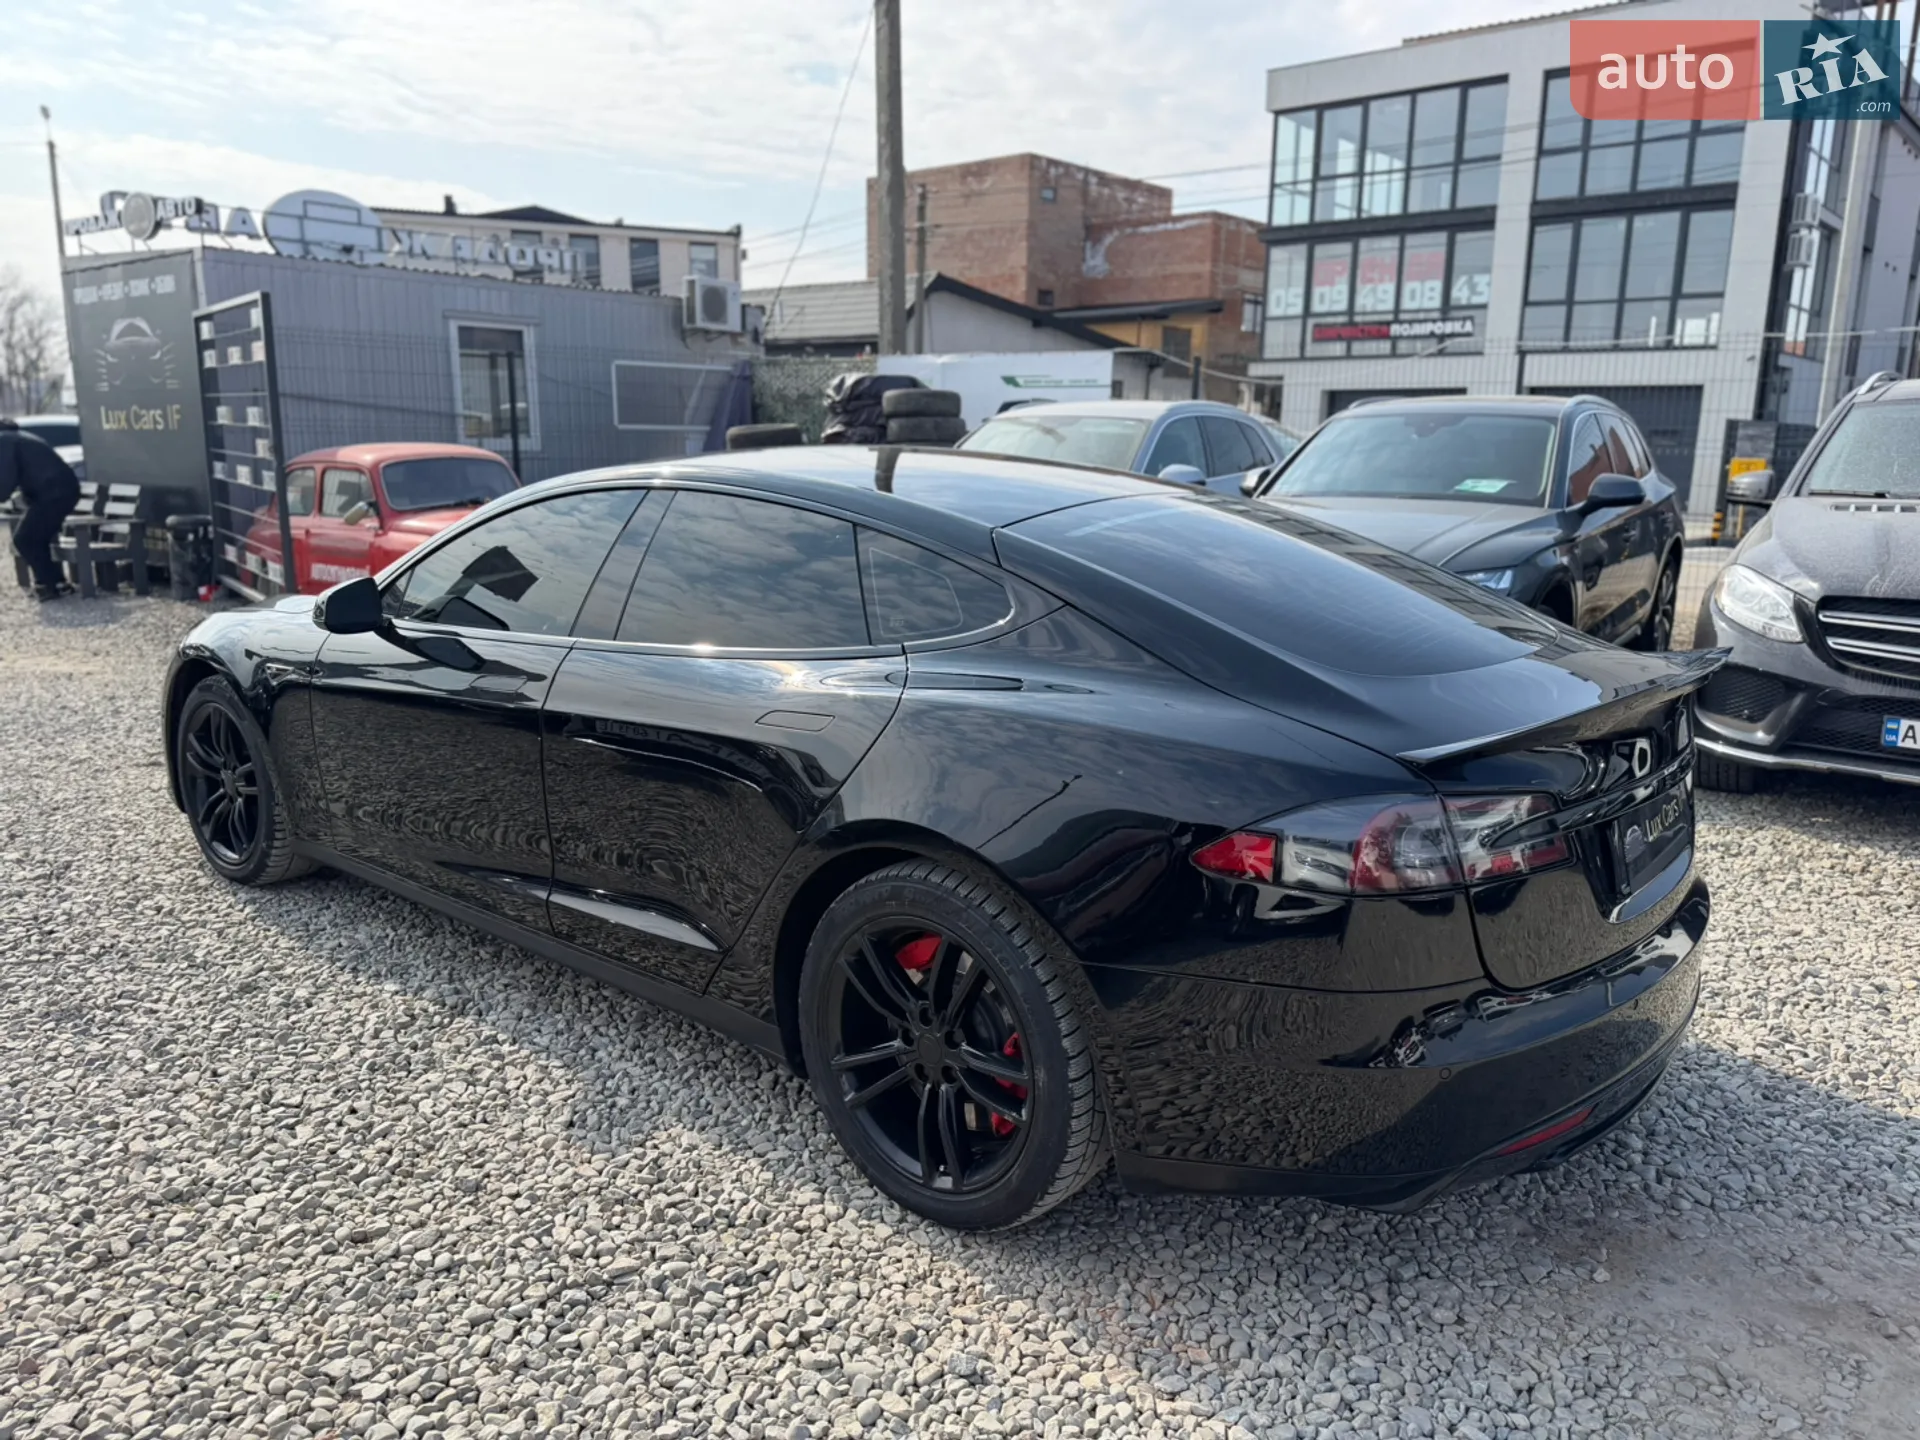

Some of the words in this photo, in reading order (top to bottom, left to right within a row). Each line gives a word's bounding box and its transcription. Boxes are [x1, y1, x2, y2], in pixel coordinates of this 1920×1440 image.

[155, 197, 200, 221] АВТО
[100, 405, 128, 430] Lux
[130, 404, 164, 430] Cars
[166, 404, 181, 429] IF
[1645, 814, 1663, 842] Lux
[1662, 799, 1679, 826] Cars
